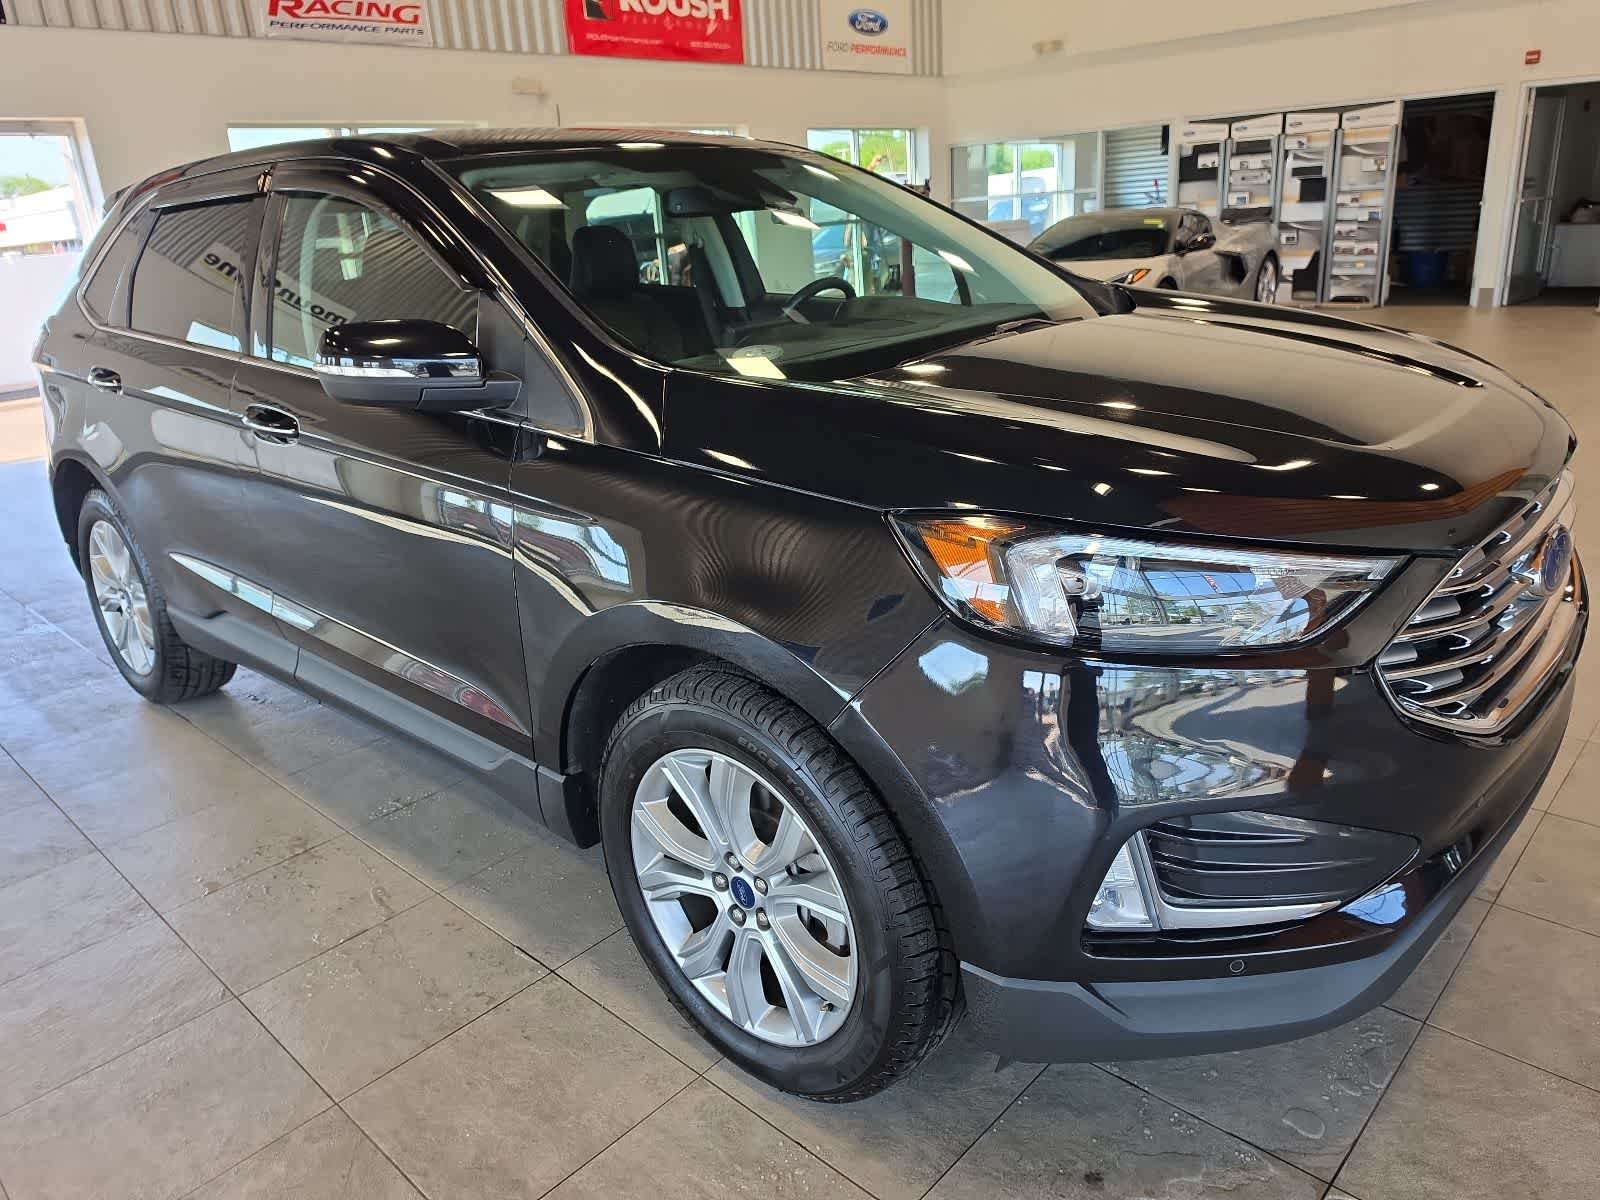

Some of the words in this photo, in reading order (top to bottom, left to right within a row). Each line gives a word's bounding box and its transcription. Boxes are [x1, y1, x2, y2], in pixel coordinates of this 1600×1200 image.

[268, 0, 421, 24] RACING
[619, 0, 730, 20] ROUSH
[270, 20, 381, 32] PERFORMANCE
[384, 27, 424, 35] PARTS
[855, 12, 881, 32] Ford
